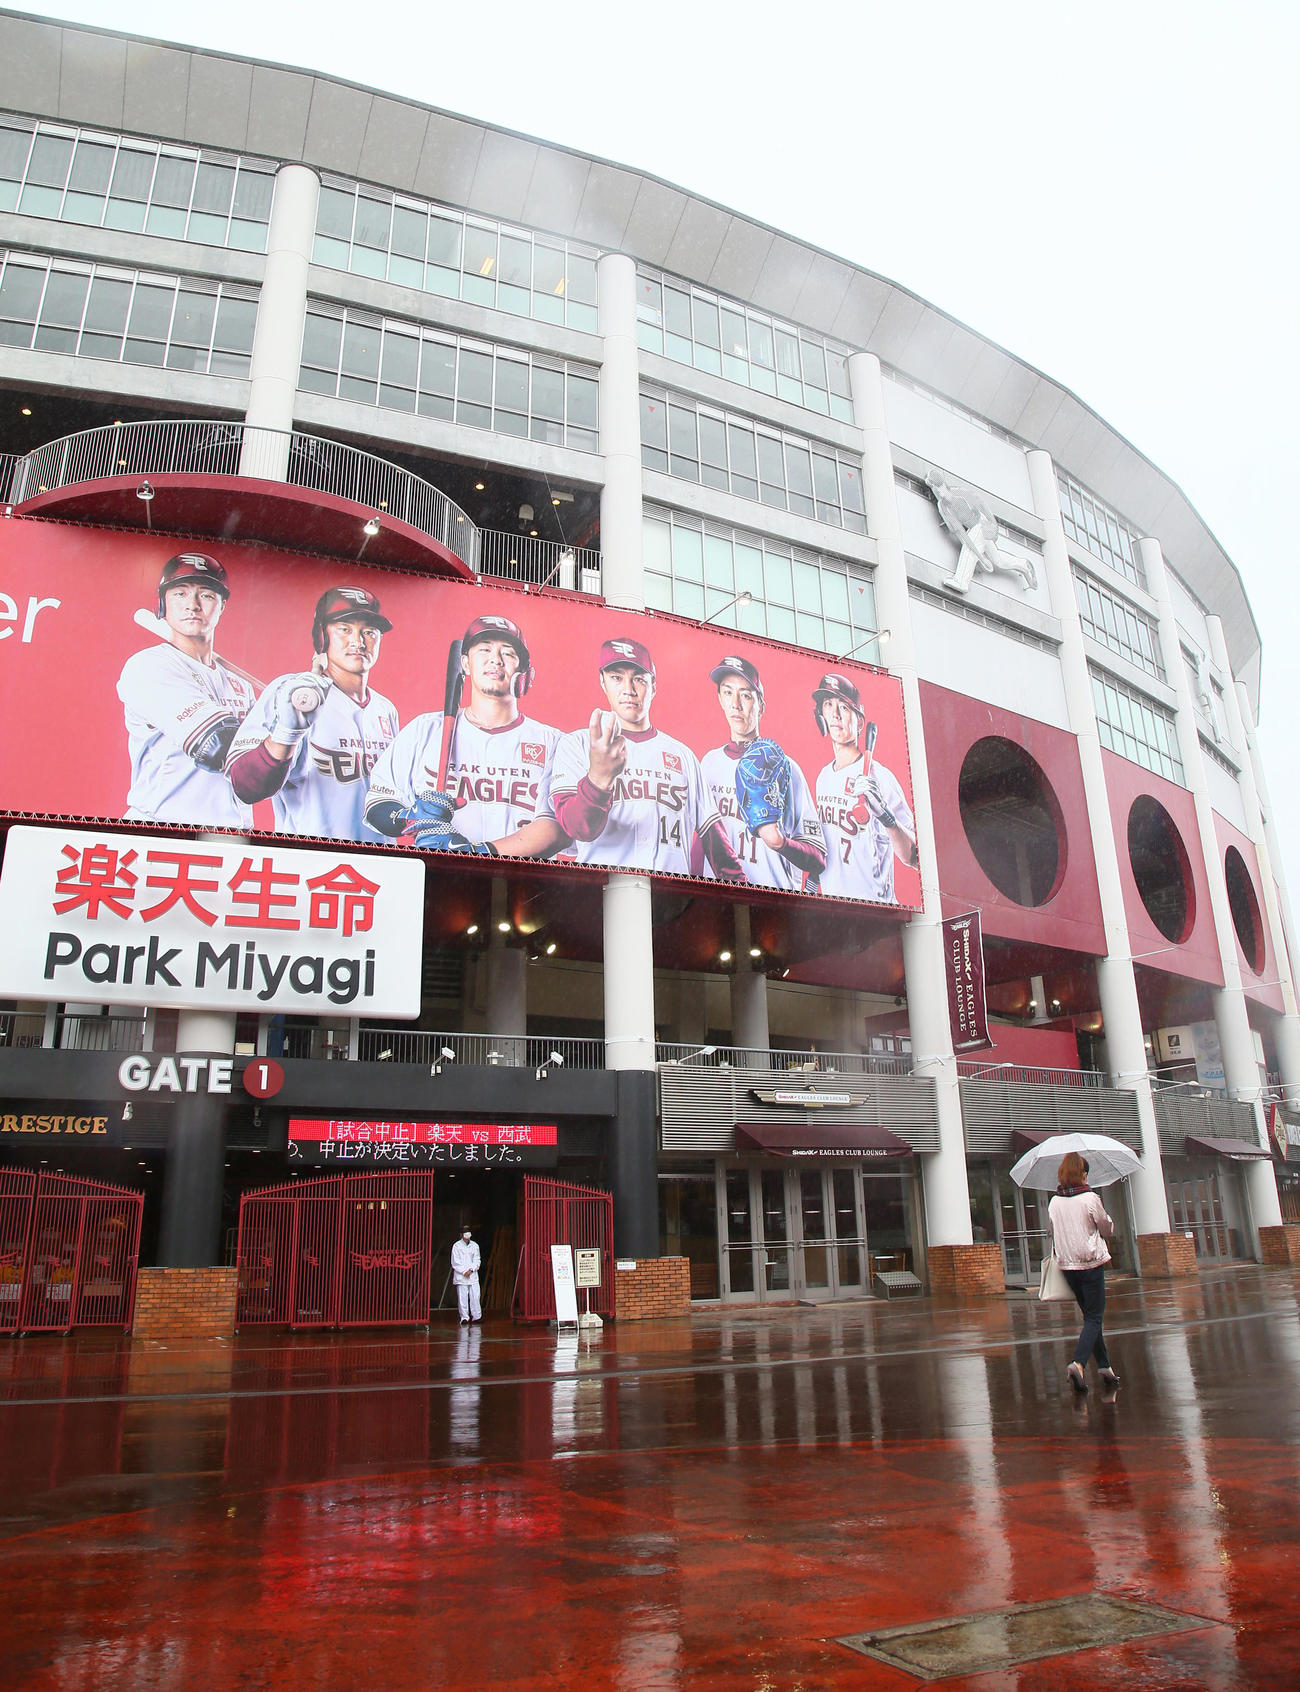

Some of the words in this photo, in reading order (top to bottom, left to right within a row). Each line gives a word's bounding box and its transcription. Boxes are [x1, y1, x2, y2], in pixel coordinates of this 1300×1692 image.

[177, 700, 206, 721] Rakute
[449, 763, 530, 778] RAKUTEN
[624, 768, 672, 781] KUTEN
[614, 777, 688, 812] AGLES
[660, 815, 681, 847] 14
[738, 832, 757, 864] 11
[841, 837, 852, 864] 7
[53, 844, 381, 937] 楽天生命
[44, 931, 182, 988] Park
[195, 940, 375, 1004] Miyagi
[953, 939, 961, 974] CLUB
[955, 976, 967, 1032] LOUNGE
[965, 983, 978, 1037] EAGLES
[118, 1055, 234, 1094] GATE
[258, 1064, 269, 1091] 1
[0, 1114, 109, 1134] RESTIGE
[427, 1123, 463, 1142] 楽天
[472, 1130, 489, 1142] vs
[497, 1124, 532, 1143] 西武
